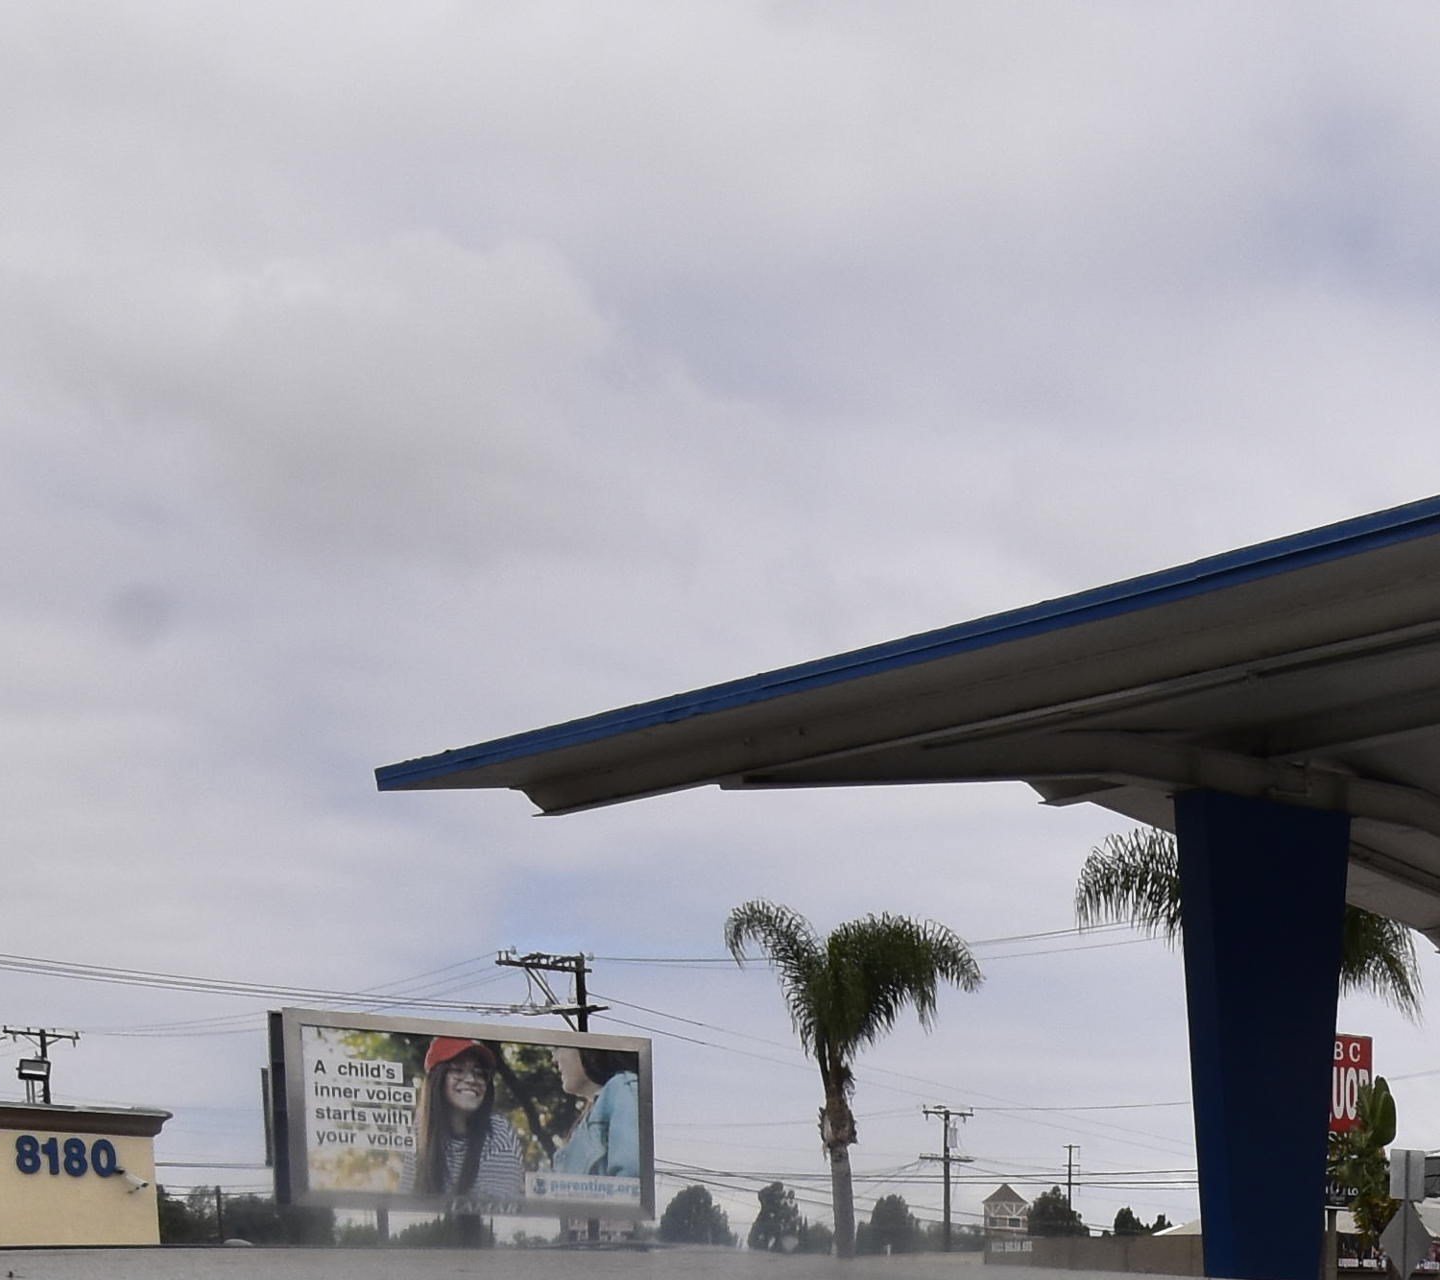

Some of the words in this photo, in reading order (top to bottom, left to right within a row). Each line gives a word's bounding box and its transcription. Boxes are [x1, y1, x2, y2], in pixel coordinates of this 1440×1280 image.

[1334, 1041, 1361, 1063] BC
[314, 1059, 327, 1074] A
[337, 1061, 396, 1080] child's
[314, 1082, 361, 1099] inner
[366, 1086, 412, 1103] voice
[314, 1105, 367, 1122] starts
[372, 1108, 409, 1124] with
[316, 1130, 357, 1146] your
[368, 1131, 414, 1147] voice
[15, 1134, 117, 1178] 8180
